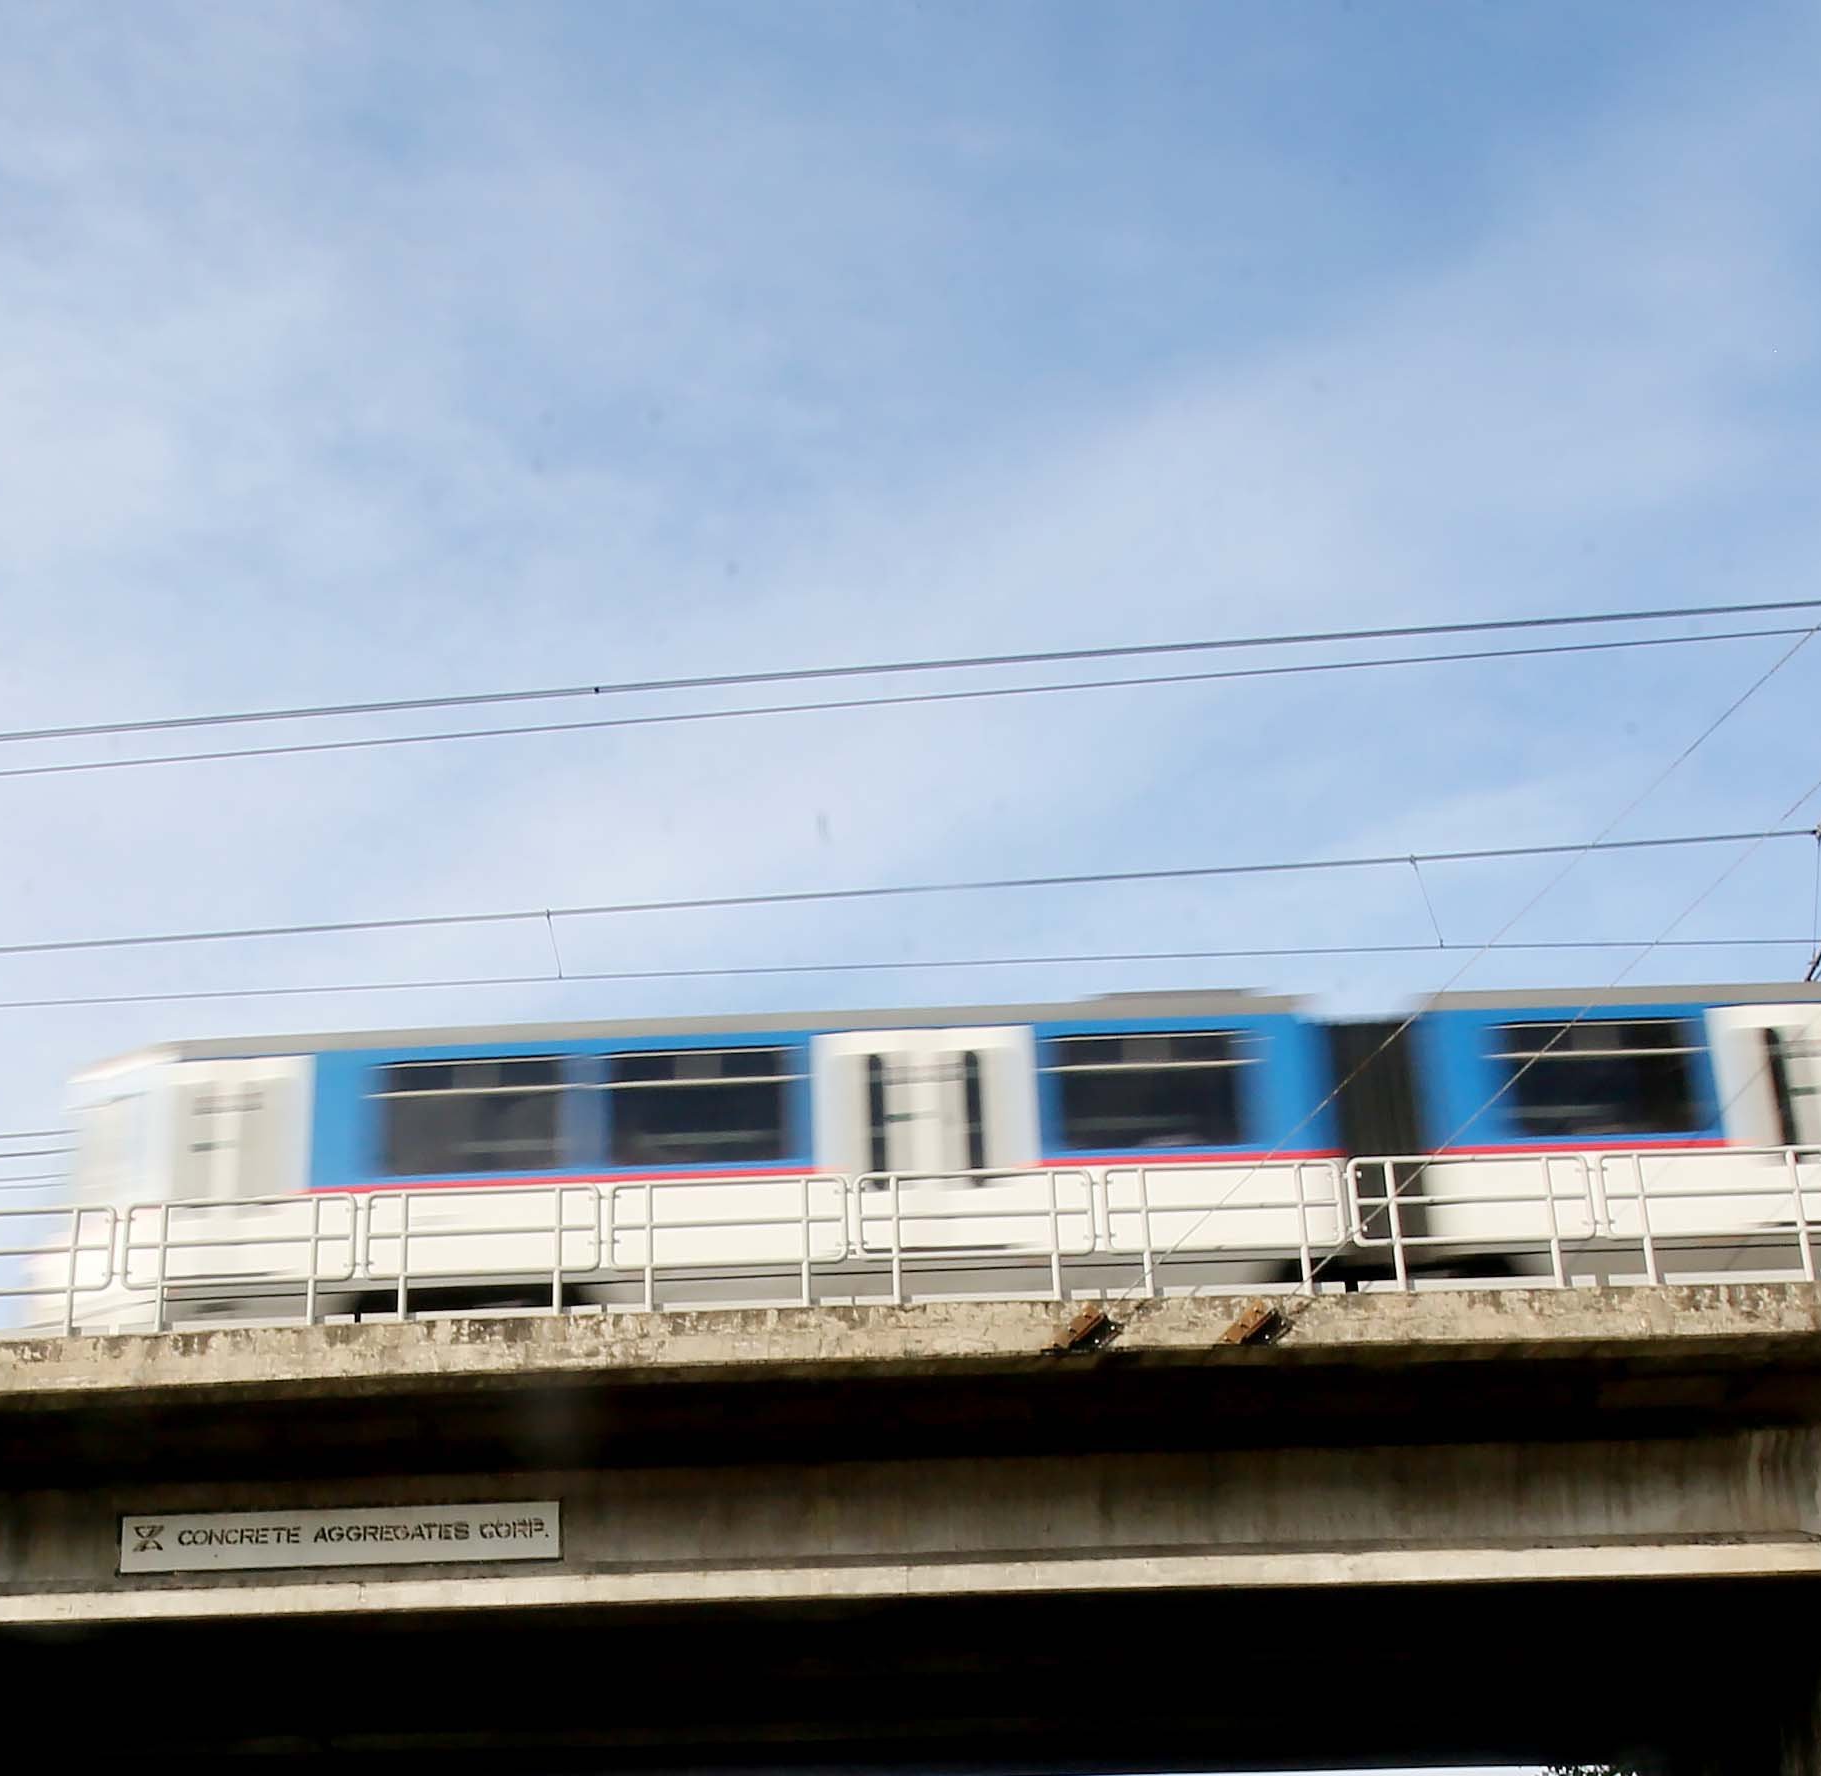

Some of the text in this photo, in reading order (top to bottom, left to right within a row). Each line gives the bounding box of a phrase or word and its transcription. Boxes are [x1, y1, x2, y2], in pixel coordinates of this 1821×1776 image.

[178, 1517, 550, 1546] CONCRETE AGGREGATES CORP.
